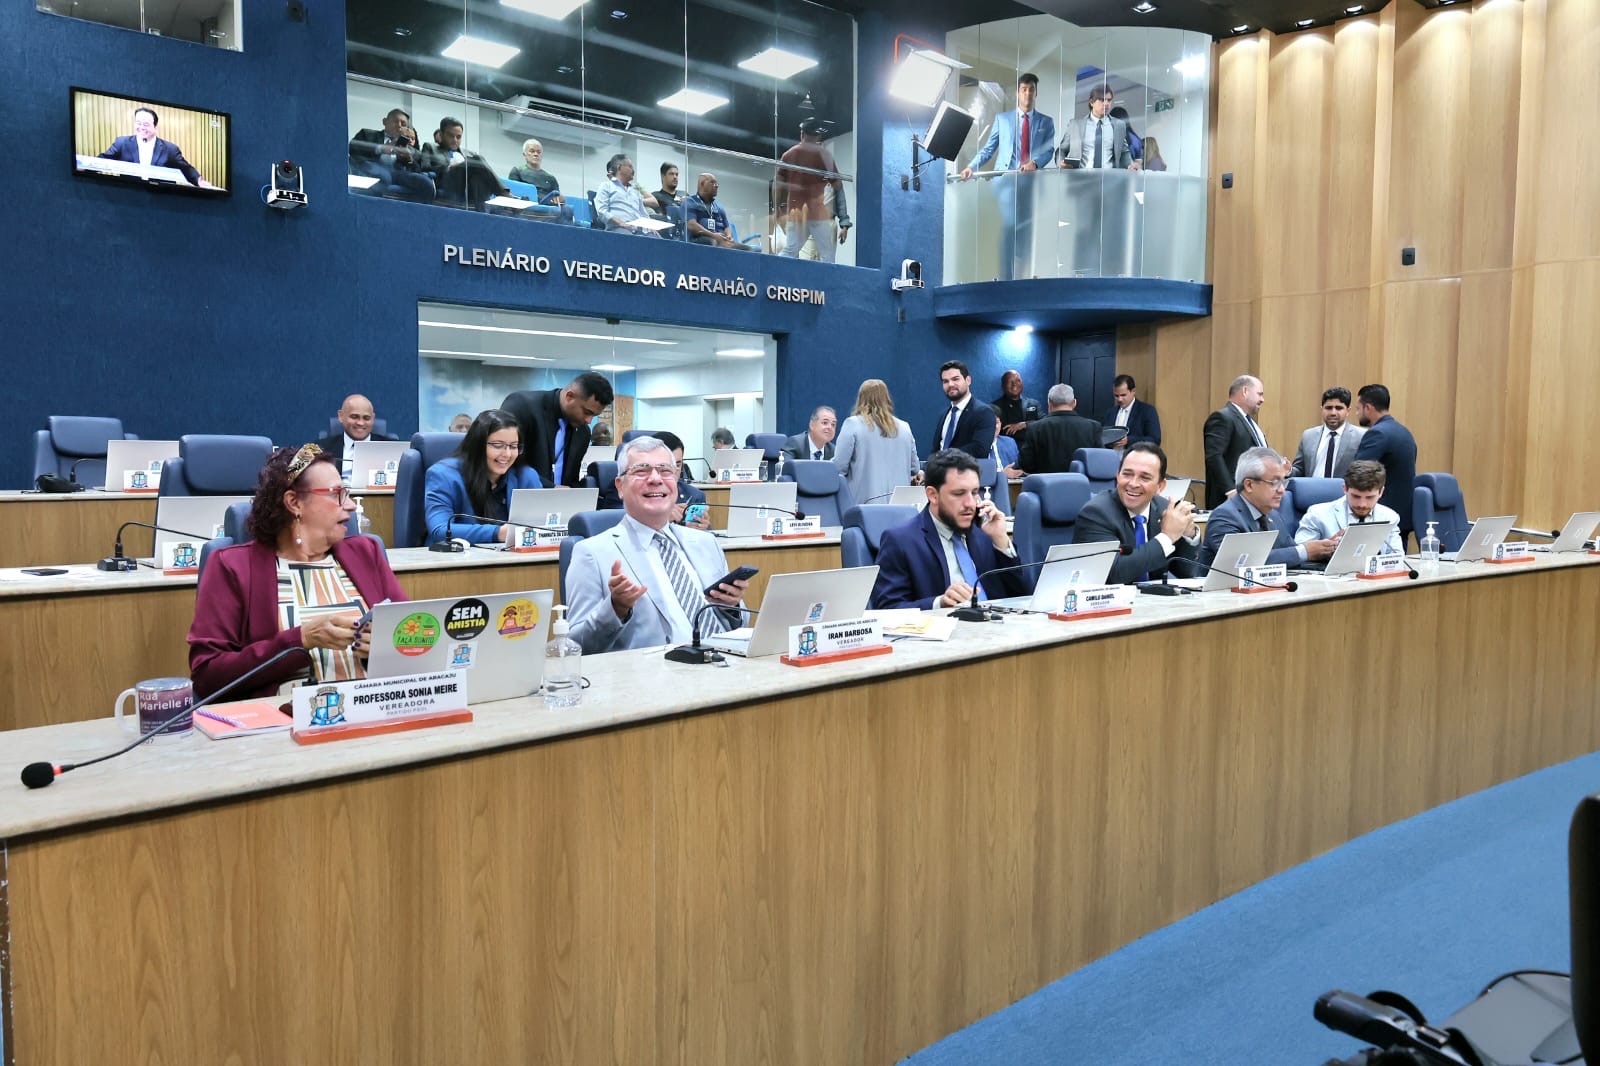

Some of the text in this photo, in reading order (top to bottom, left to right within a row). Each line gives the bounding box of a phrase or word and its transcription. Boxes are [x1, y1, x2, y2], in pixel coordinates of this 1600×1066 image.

[444, 244, 825, 304] PLENÁRIO VEREADOR ABRAHÃO CRISPIM
[452, 605, 483, 621] SEM
[447, 618, 485, 630] ANISTIA
[828, 627, 873, 640] IRAN BARBOSA
[140, 692, 158, 700] Rua
[353, 683, 458, 705] PROFESSORA SONIA MEIRE
[140, 700, 182, 711] Marielle
[379, 698, 435, 711] VEREADORA
